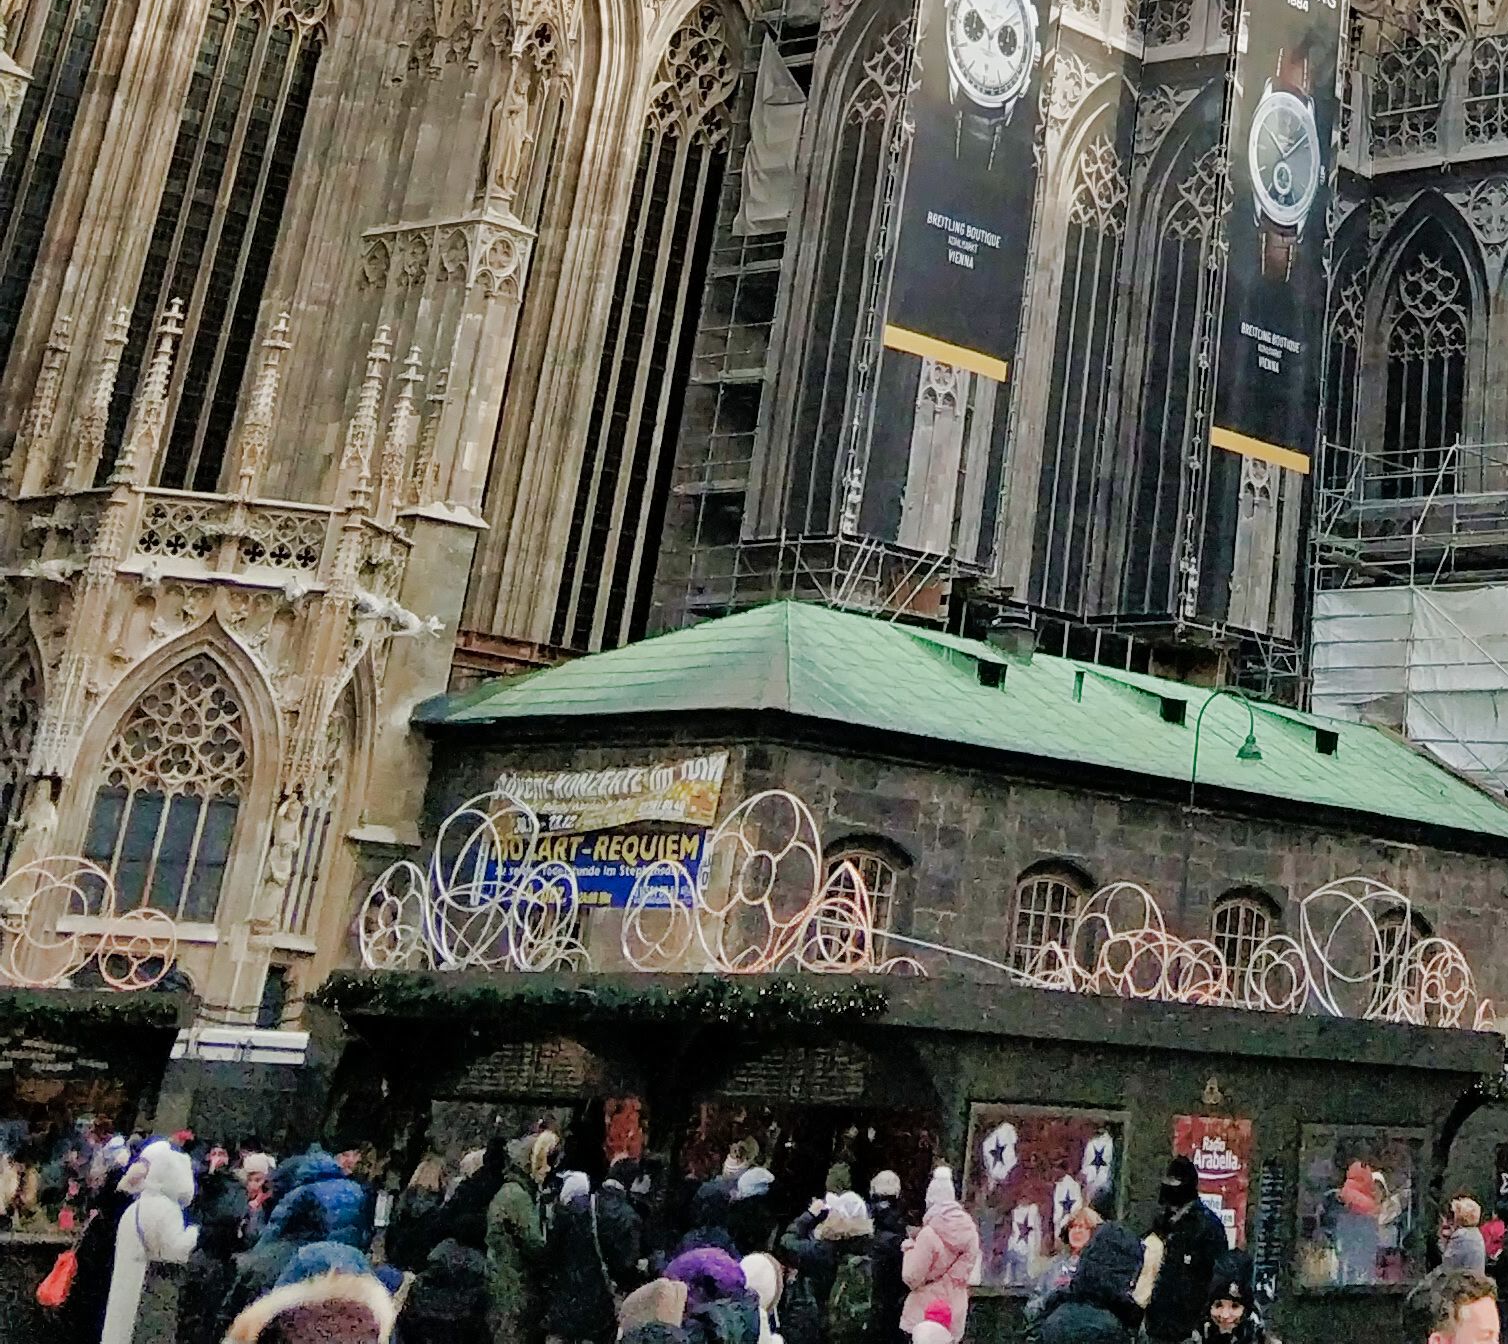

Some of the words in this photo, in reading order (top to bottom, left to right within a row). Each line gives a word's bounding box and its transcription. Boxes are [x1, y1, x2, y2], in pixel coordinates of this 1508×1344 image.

[927, 211, 966, 236] BREITLING
[966, 224, 1001, 249] BOUTIQUE
[947, 248, 975, 270] VIENNA
[1193, 1148, 1239, 1170] Arabella
